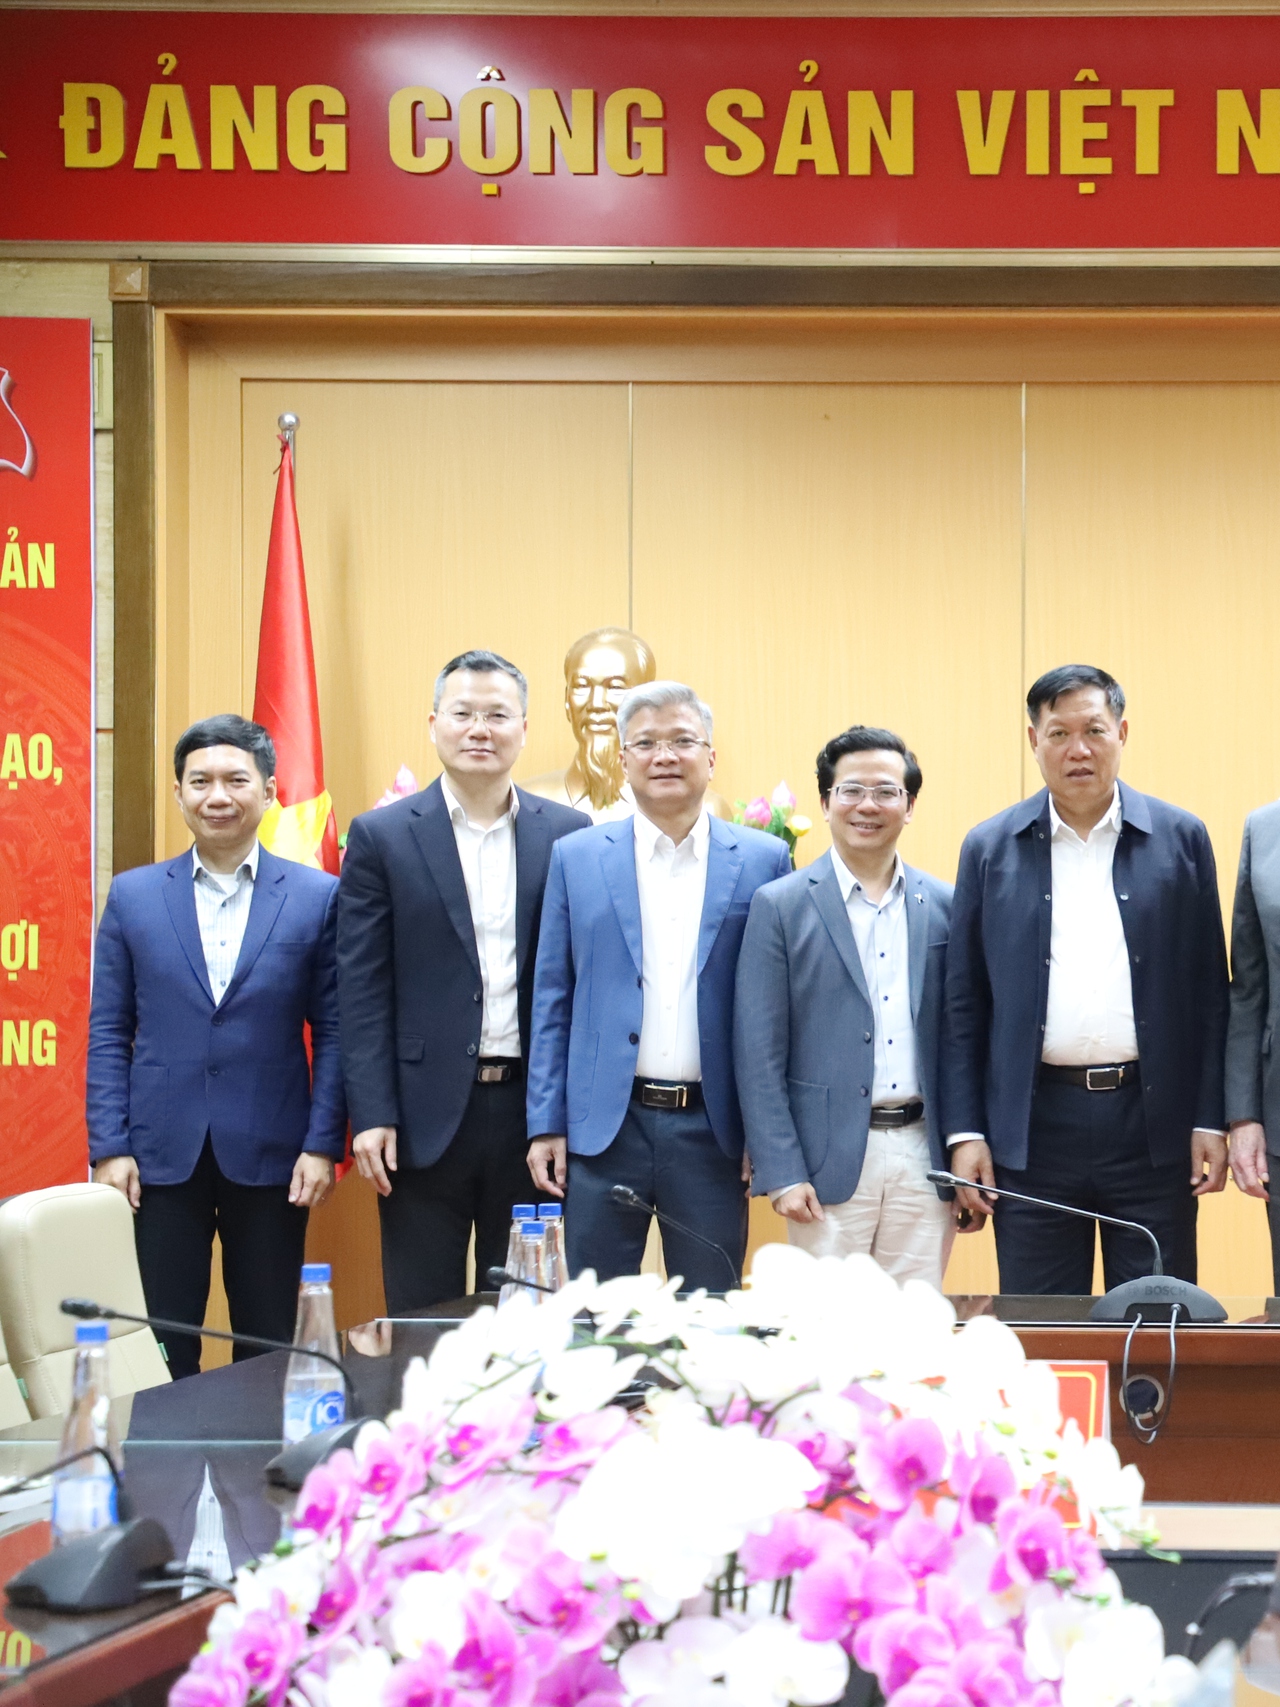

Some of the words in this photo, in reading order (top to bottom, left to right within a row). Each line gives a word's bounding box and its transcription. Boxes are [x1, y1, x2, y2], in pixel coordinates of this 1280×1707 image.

[59, 52, 350, 174] ĐẢNG
[388, 65, 666, 197] CỘNG
[704, 60, 916, 176] SẢN
[956, 69, 1175, 194] VIỆT
[0, 1018, 57, 1067] NG
[1144, 1285, 1187, 1297] BOSCH
